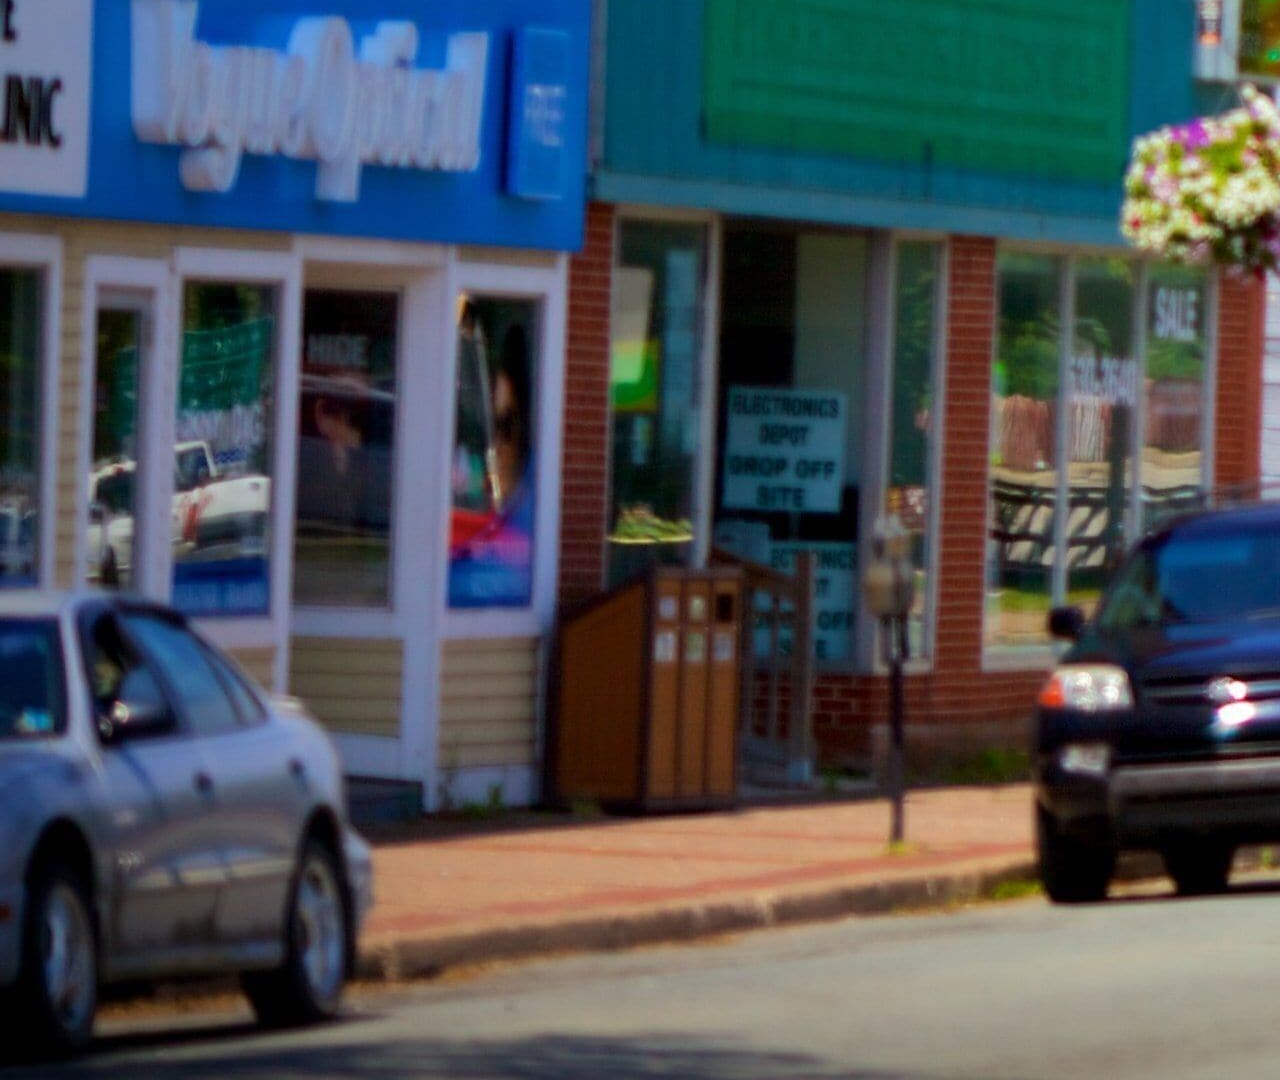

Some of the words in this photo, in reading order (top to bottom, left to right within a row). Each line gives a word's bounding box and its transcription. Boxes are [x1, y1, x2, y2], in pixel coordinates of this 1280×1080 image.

[0, 74, 62, 149] INIC
[287, 16, 488, 202] Optical
[732, 393, 840, 418] ELECTRONICS
[758, 423, 809, 445] DEPOT
[729, 455, 787, 477] DROP
[795, 459, 836, 480] OFF
[757, 485, 805, 507] SITE
